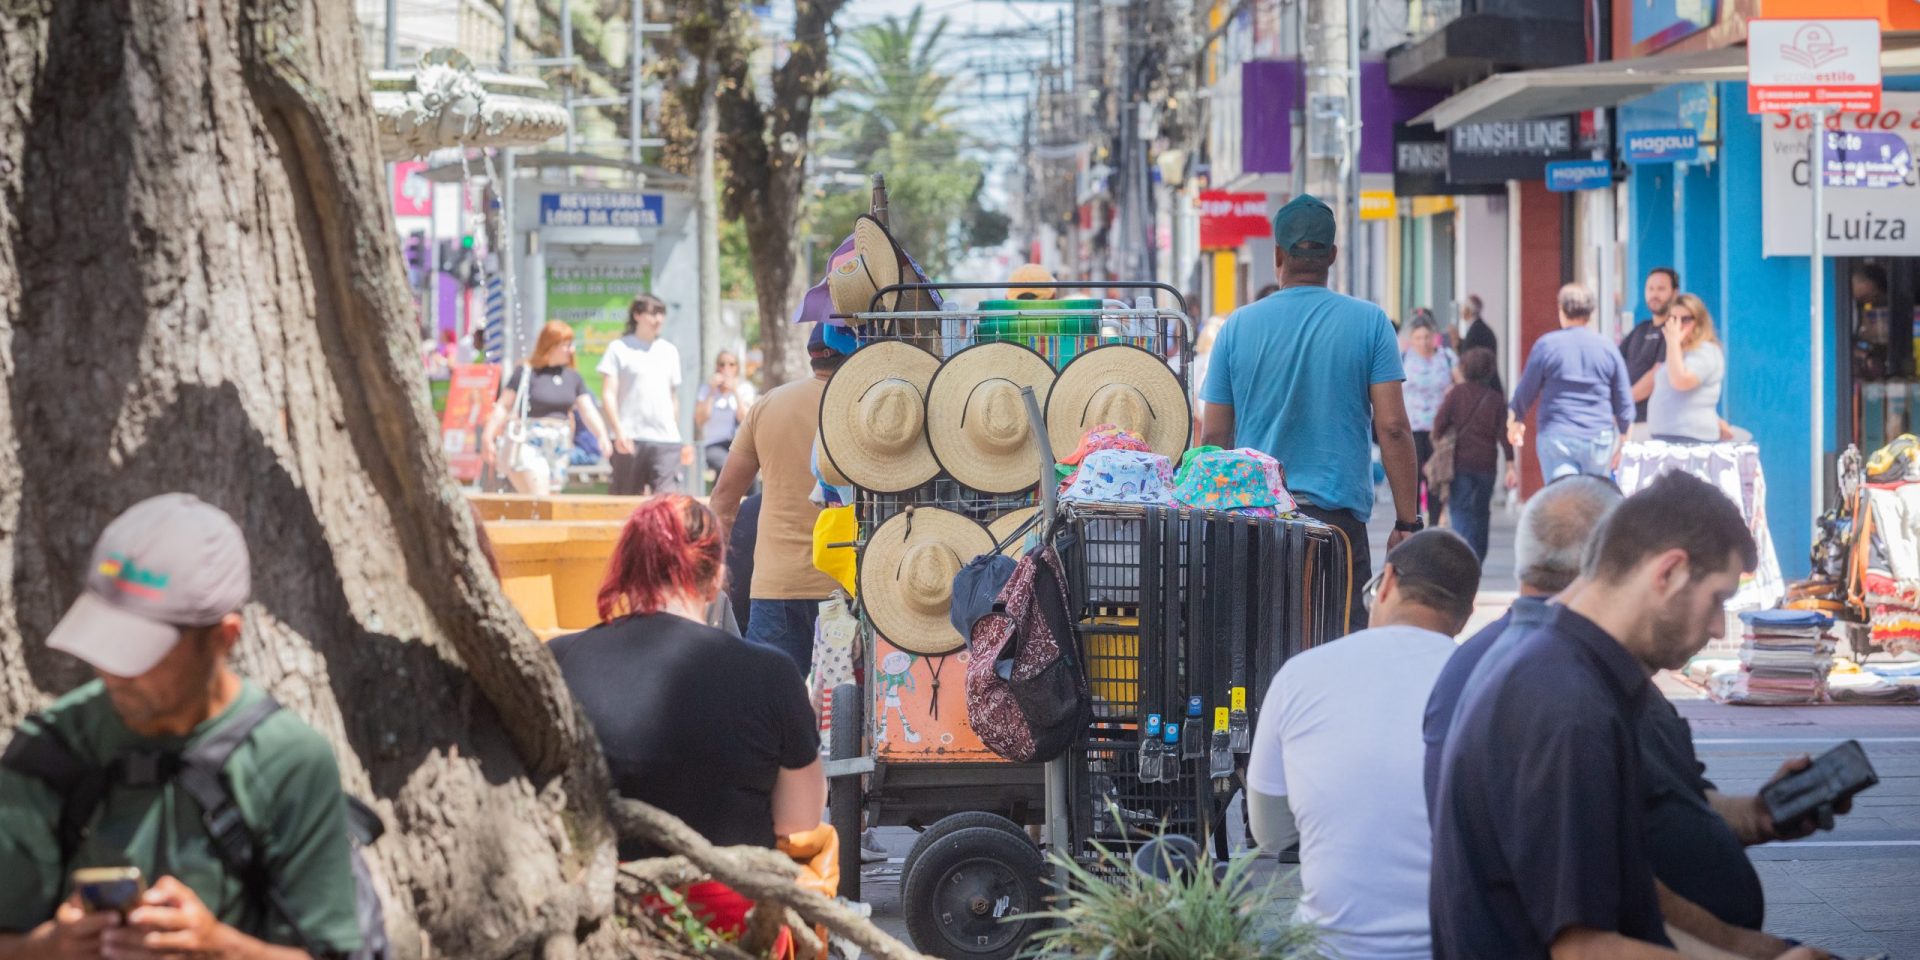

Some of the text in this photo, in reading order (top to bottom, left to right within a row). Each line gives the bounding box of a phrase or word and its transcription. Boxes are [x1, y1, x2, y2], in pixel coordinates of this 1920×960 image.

[1455, 119, 1568, 149] FINISH LINE
[1630, 136, 1694, 154] Magalu
[559, 193, 645, 209] REVISTARIA
[1826, 212, 1906, 241] Luiza
